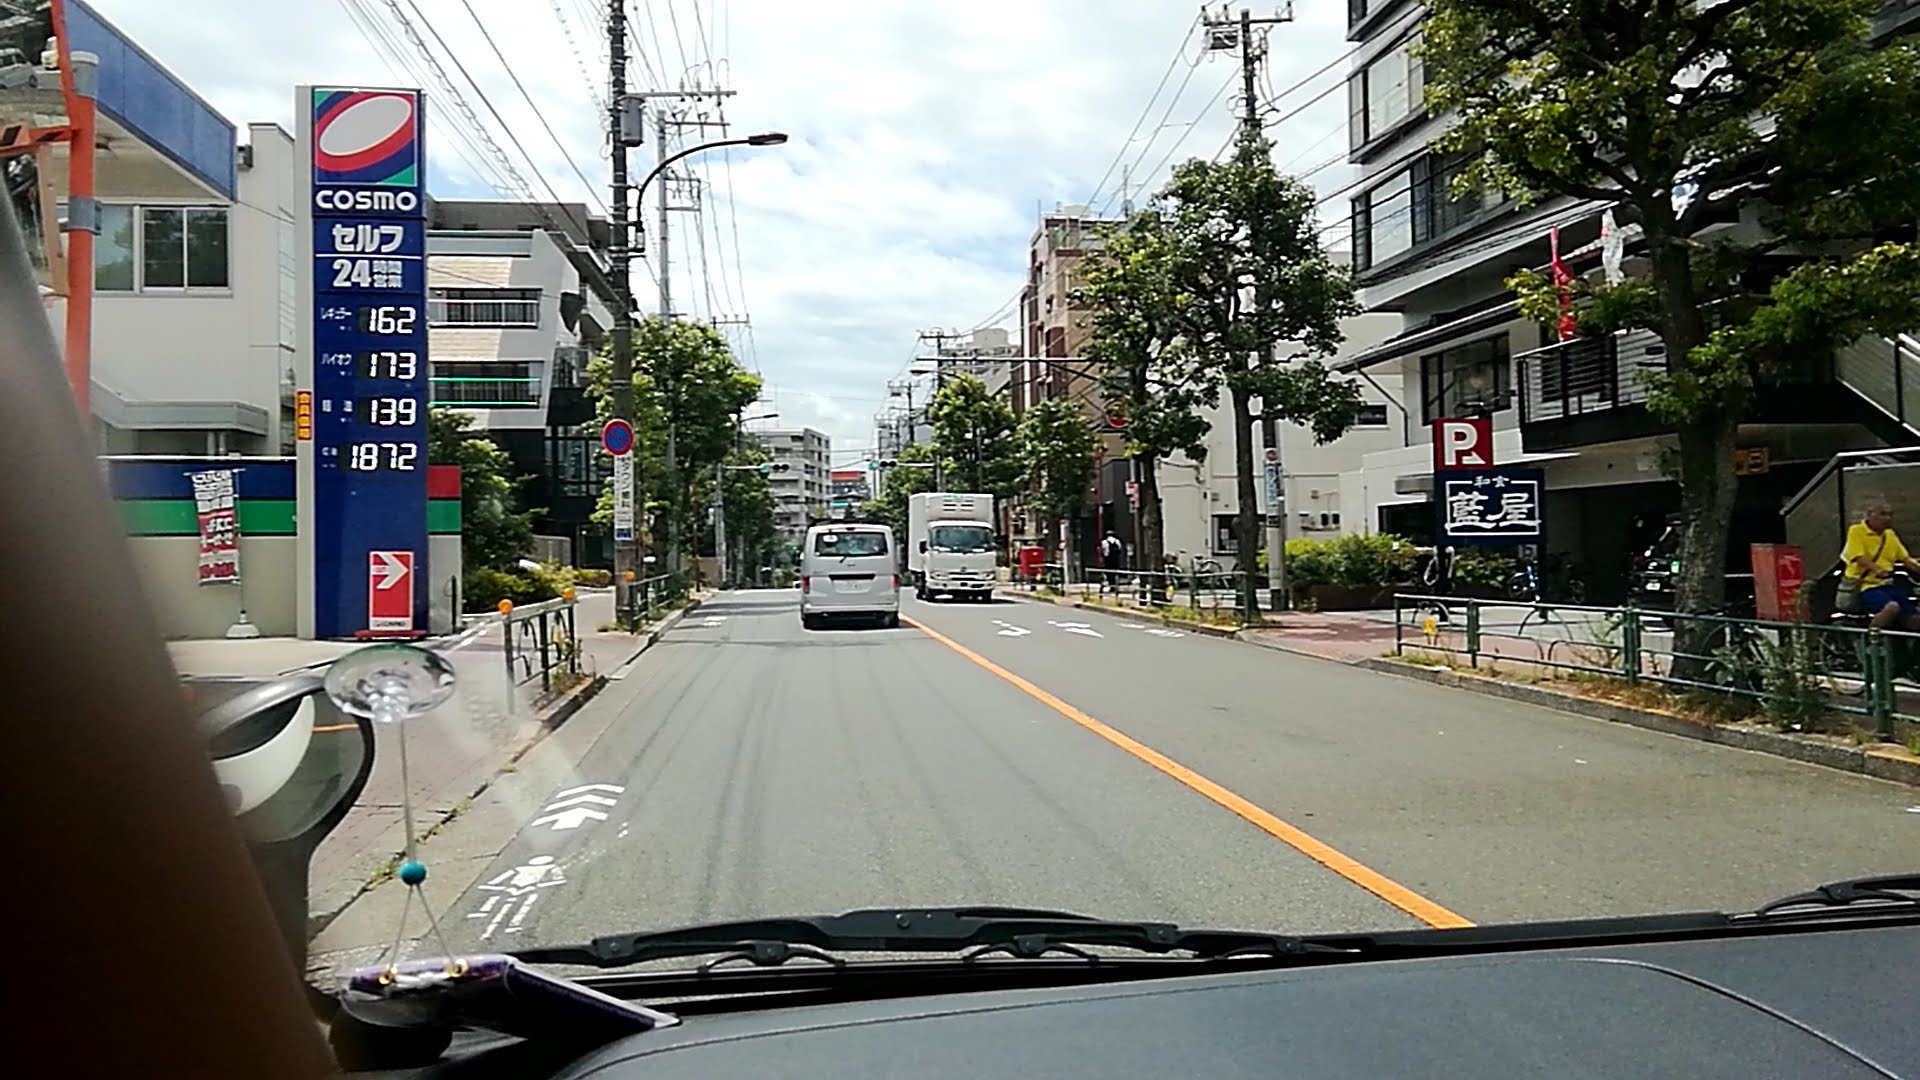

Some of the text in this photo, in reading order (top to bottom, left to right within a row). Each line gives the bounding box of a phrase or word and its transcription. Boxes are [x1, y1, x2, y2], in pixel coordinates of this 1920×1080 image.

[316, 190, 417, 211] COSMO
[332, 224, 404, 253] セルフ
[332, 259, 371, 287] 24
[369, 306, 416, 334] 162
[369, 352, 416, 379] 173
[371, 398, 416, 425] 139
[351, 443, 417, 470] 1872
